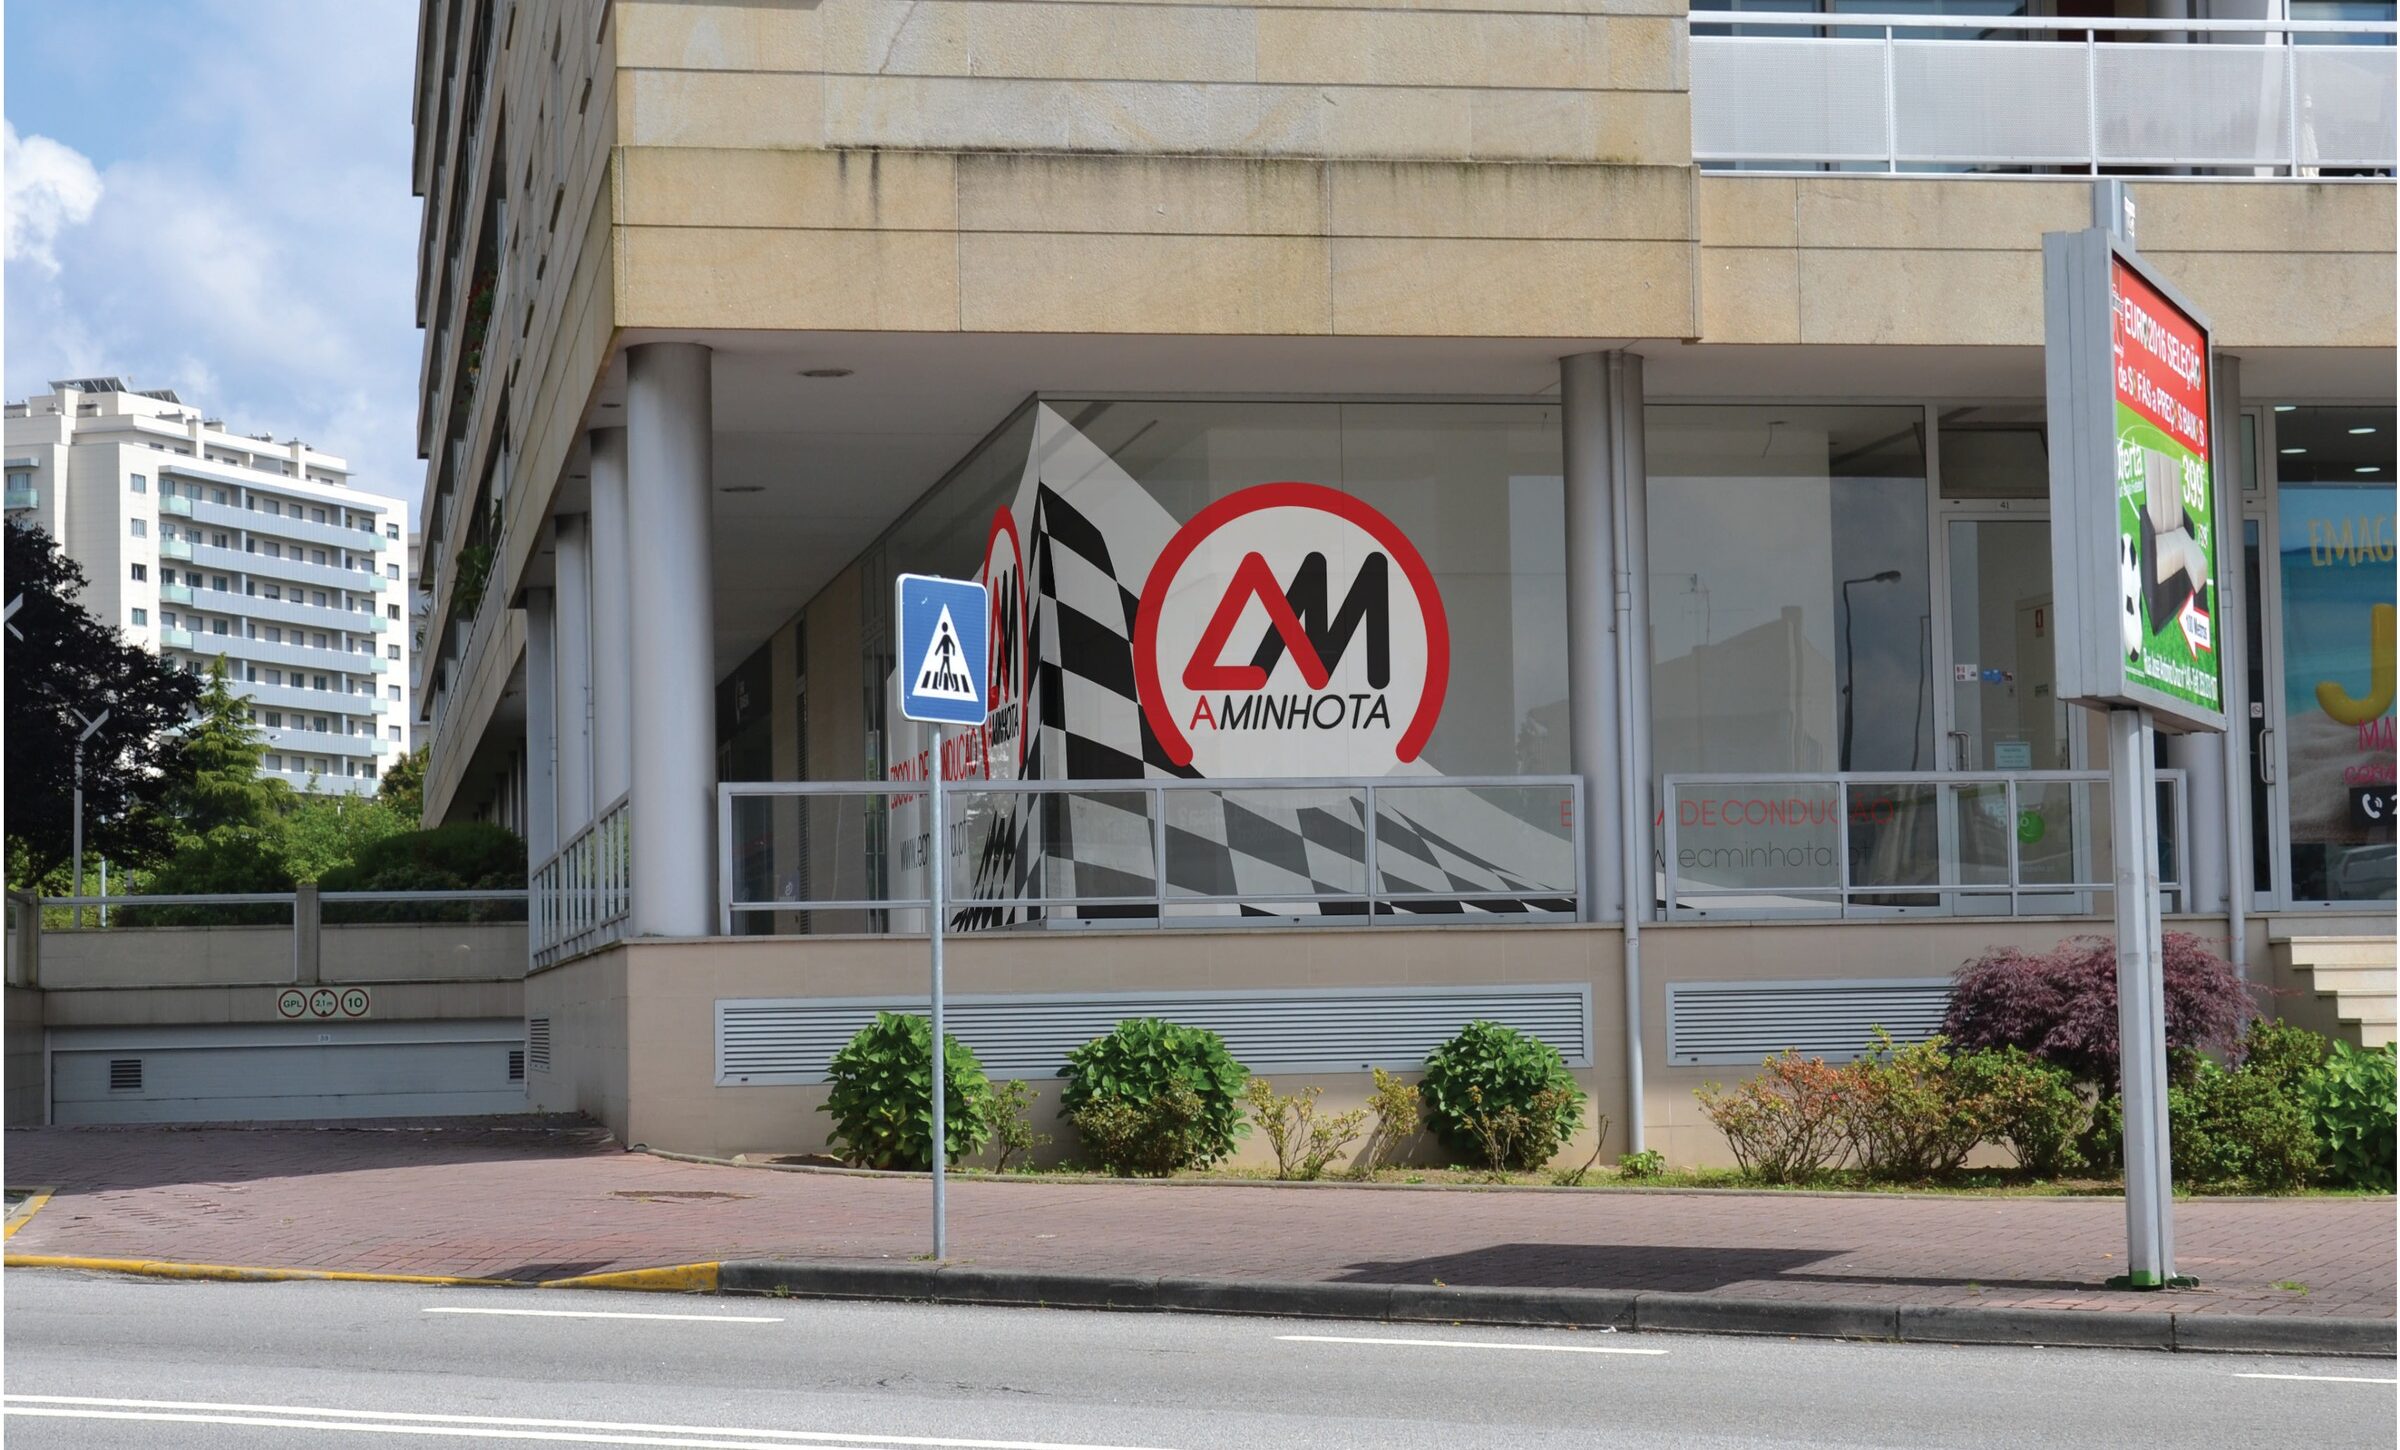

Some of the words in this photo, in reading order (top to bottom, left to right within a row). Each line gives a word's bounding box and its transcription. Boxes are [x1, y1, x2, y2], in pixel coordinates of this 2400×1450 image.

[2148, 316, 2167, 362] 2016
[2168, 333, 2202, 391] SELEÇÃO
[2117, 360, 2127, 392] de
[2000, 501, 2009, 510] 41
[2307, 511, 2397, 567] EMAG
[1680, 800, 1716, 827] DE
[283, 1000, 302, 1009] GPL
[348, 997, 363, 1009] 10
